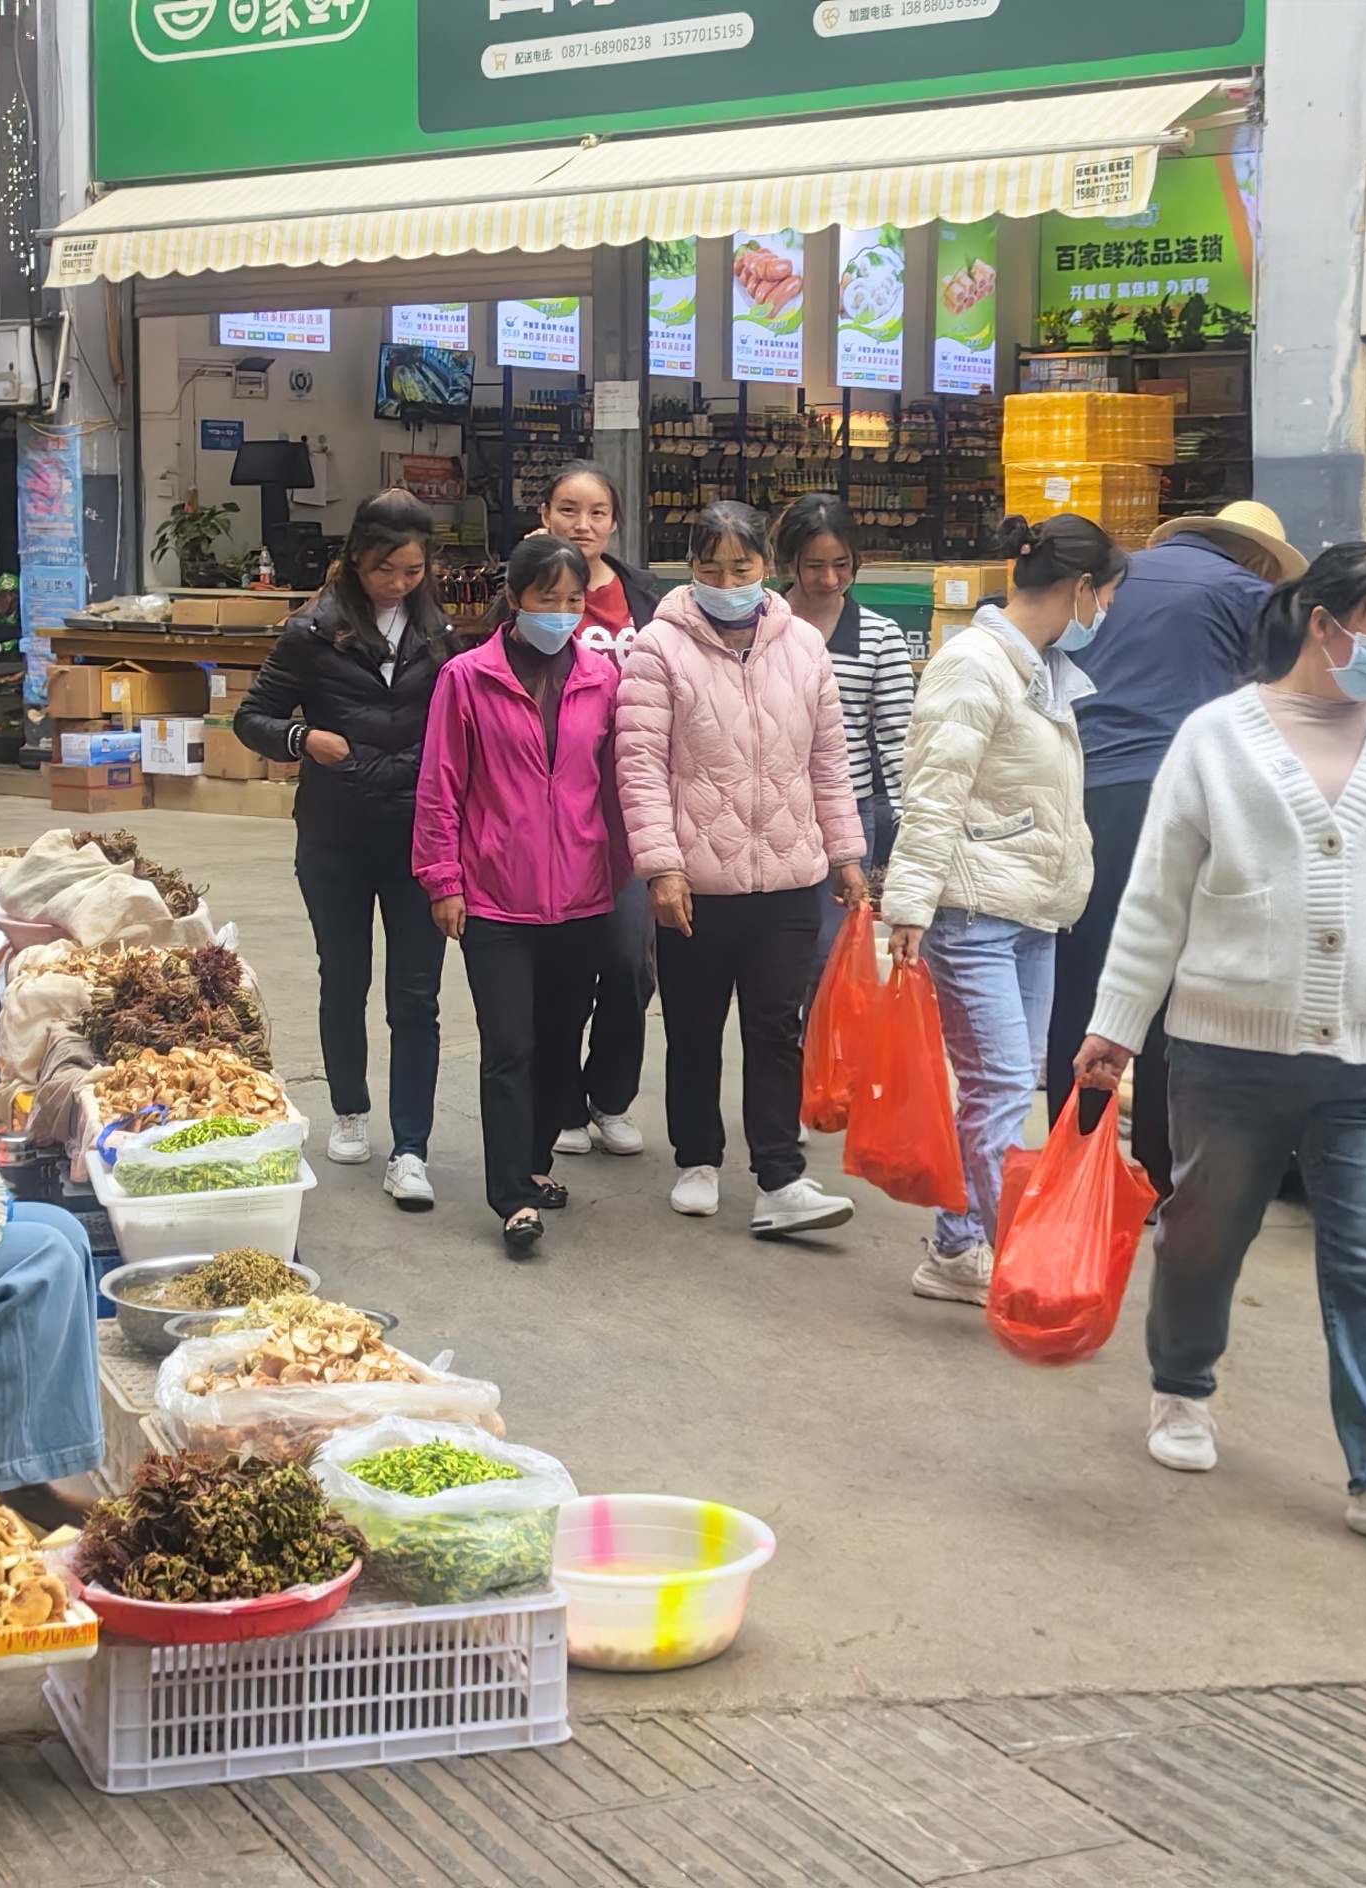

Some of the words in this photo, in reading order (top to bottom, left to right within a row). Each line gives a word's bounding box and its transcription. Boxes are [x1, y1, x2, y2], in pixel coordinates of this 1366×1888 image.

[561, 36, 652, 59] 0871-68908238
[662, 23, 744, 47] 13577015195
[1055, 234, 1224, 271] 百家鲜冻品连锁
